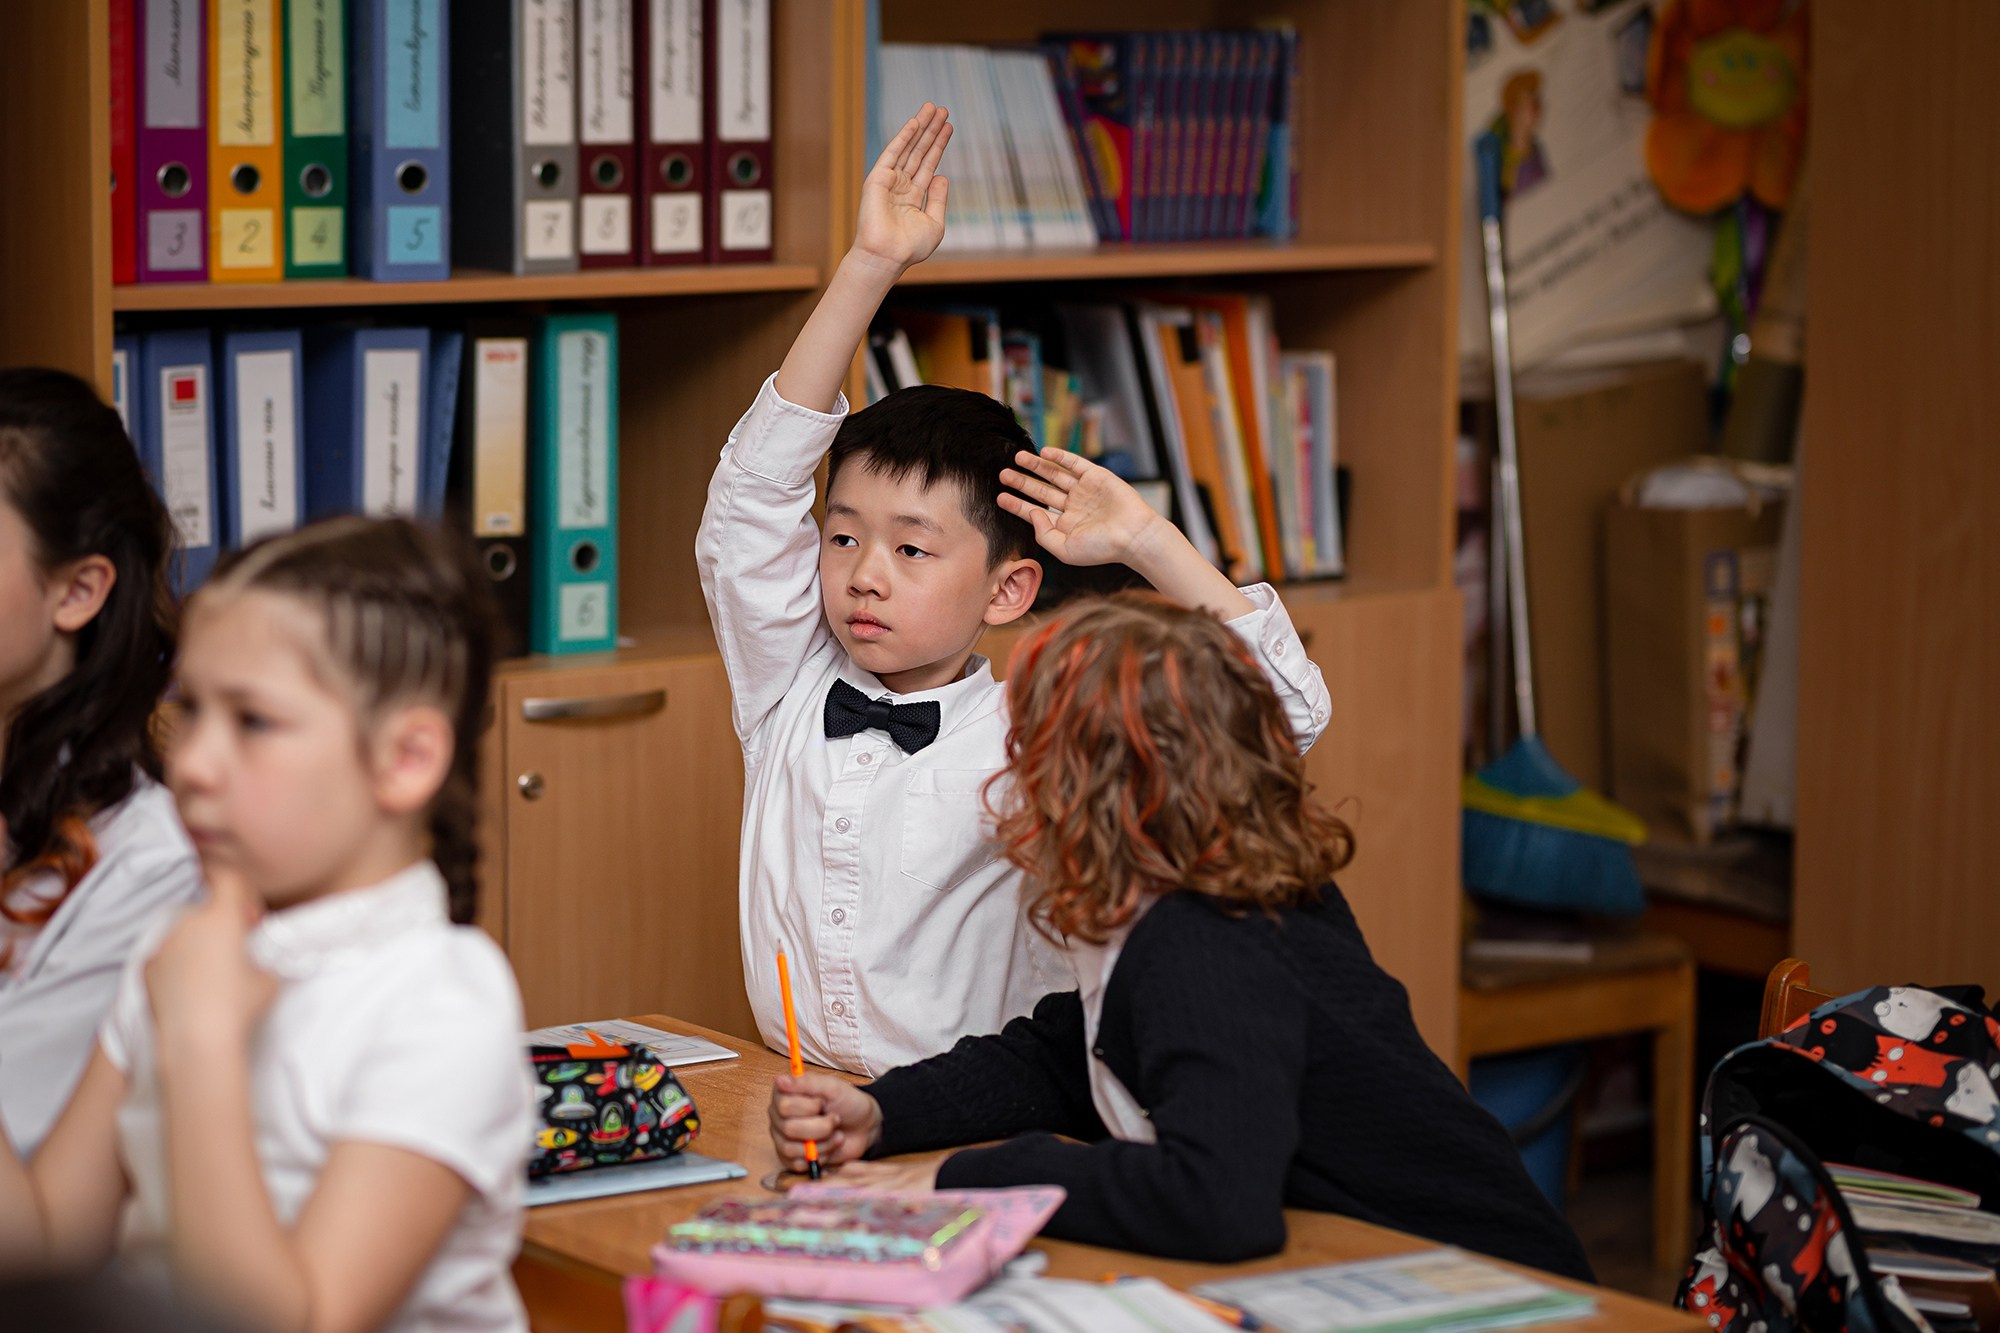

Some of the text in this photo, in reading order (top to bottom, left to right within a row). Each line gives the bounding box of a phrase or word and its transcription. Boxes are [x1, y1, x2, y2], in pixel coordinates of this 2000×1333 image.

[238, 218, 262, 254] 2
[310, 218, 327, 251] 4
[406, 217, 431, 251] 5
[542, 211, 561, 244] 7
[598, 206, 617, 240] 8
[670, 205, 690, 239] 9
[736, 202, 763, 237] 10
[167, 221, 187, 257] 3
[575, 591, 598, 629] 6
